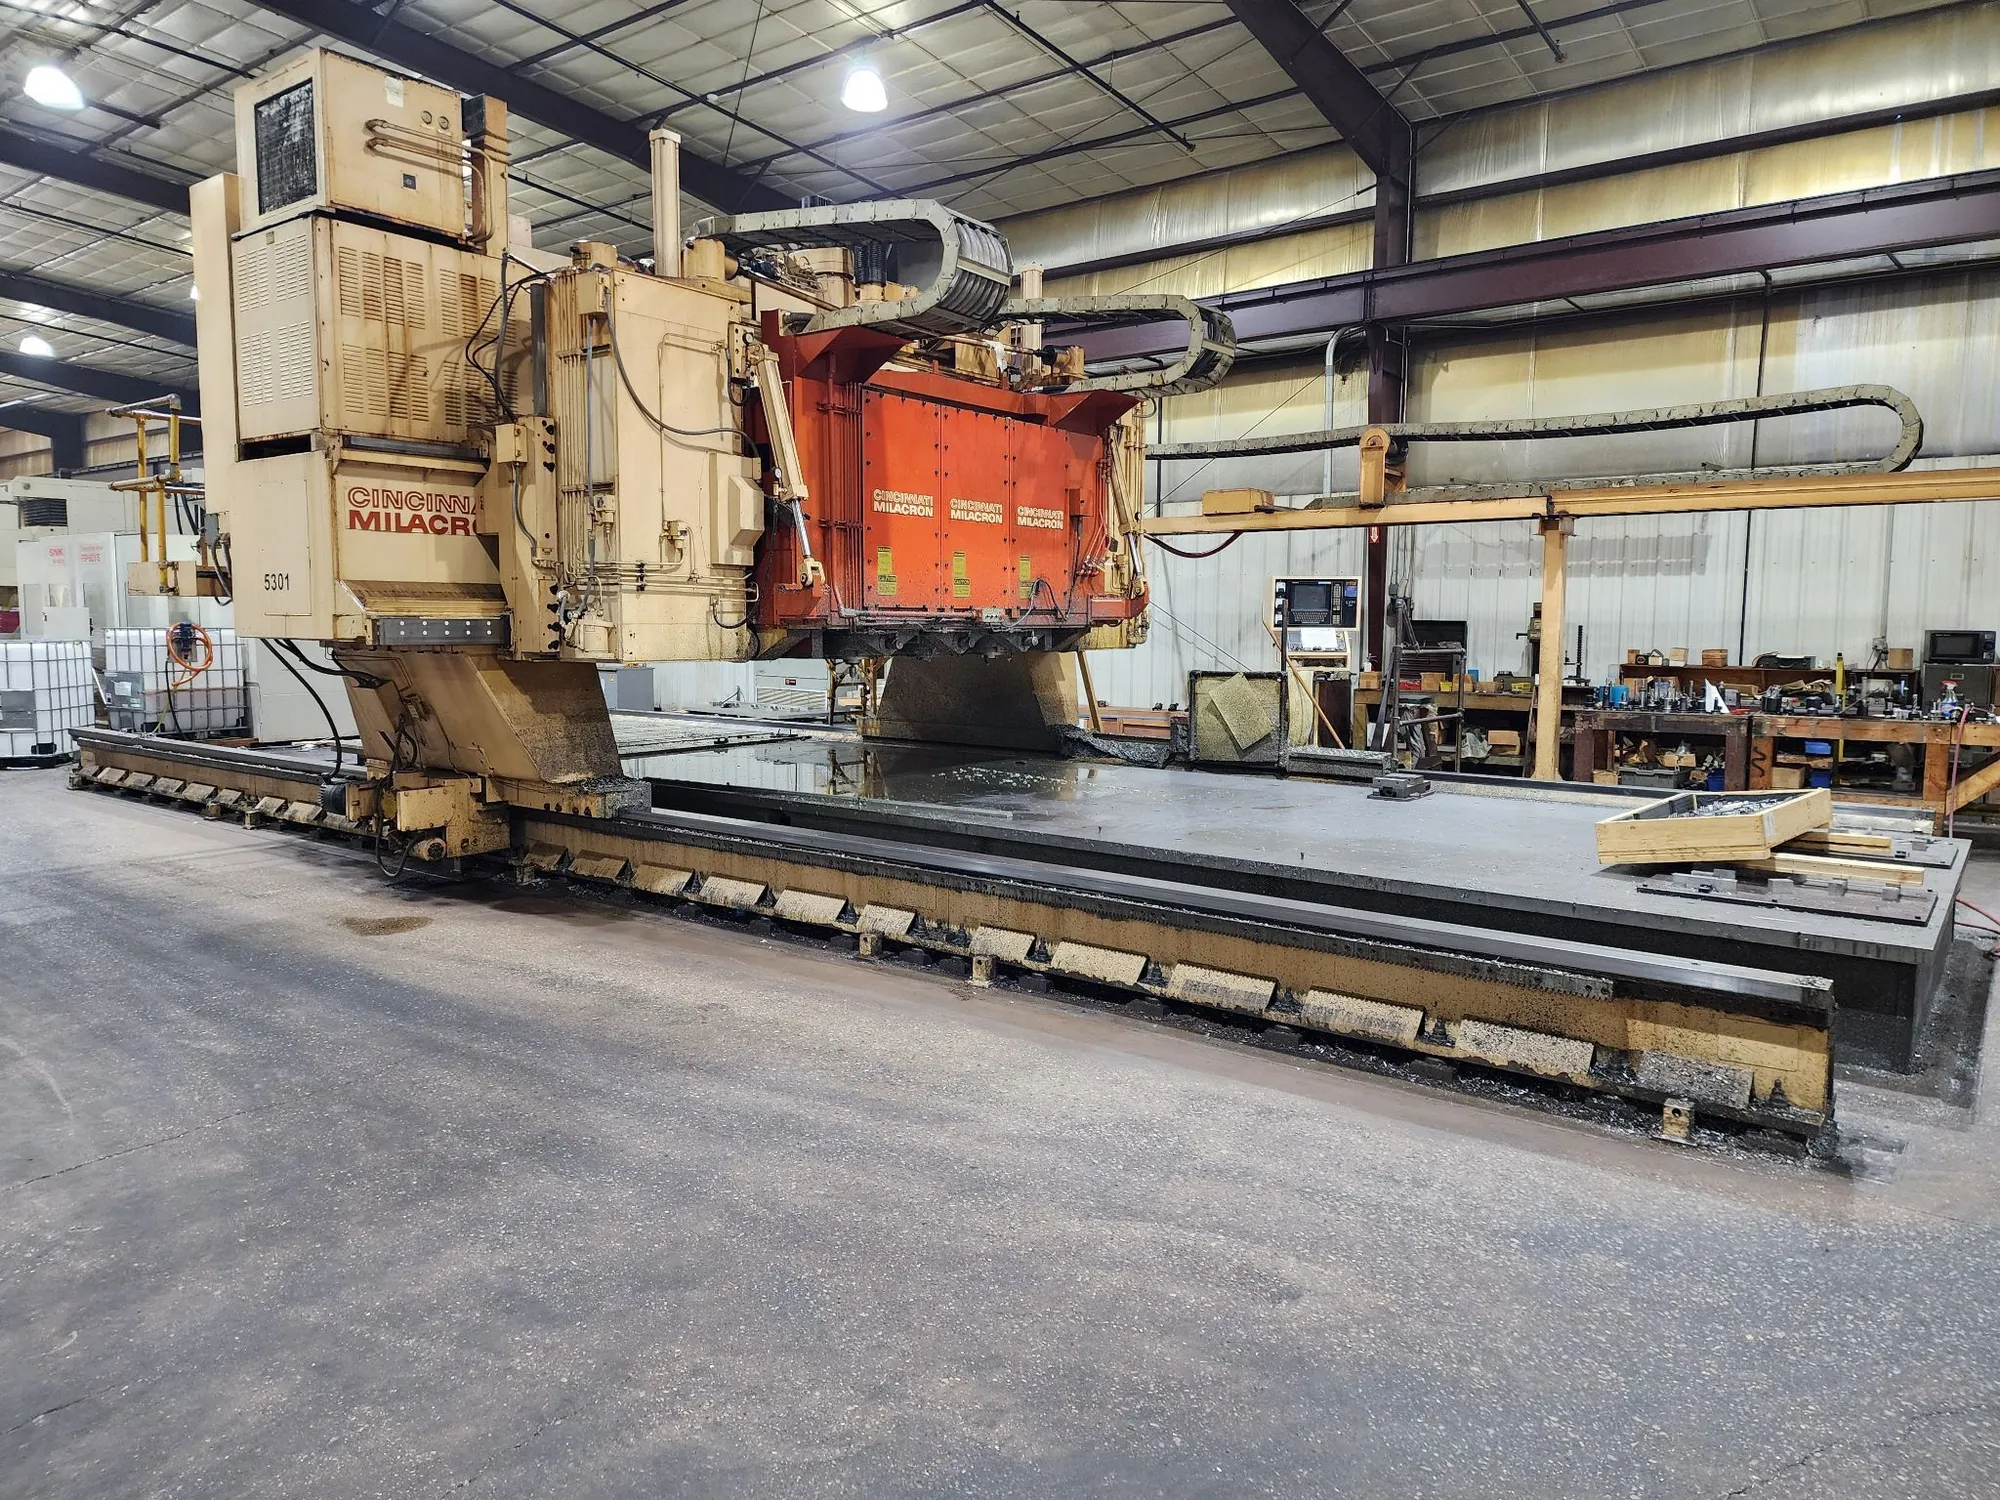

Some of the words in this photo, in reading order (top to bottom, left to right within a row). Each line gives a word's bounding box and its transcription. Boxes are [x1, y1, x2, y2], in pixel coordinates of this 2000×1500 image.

[873, 489, 933, 507] CINCINNATI
[950, 498, 1003, 513] CINCINNATI
[873, 501, 934, 517] MILACRON
[950, 509, 1003, 524] MILACRON
[1017, 505, 1064, 520] CINCINNATI
[1017, 516, 1064, 530] MILACRON
[264, 573, 290, 591] 5301
